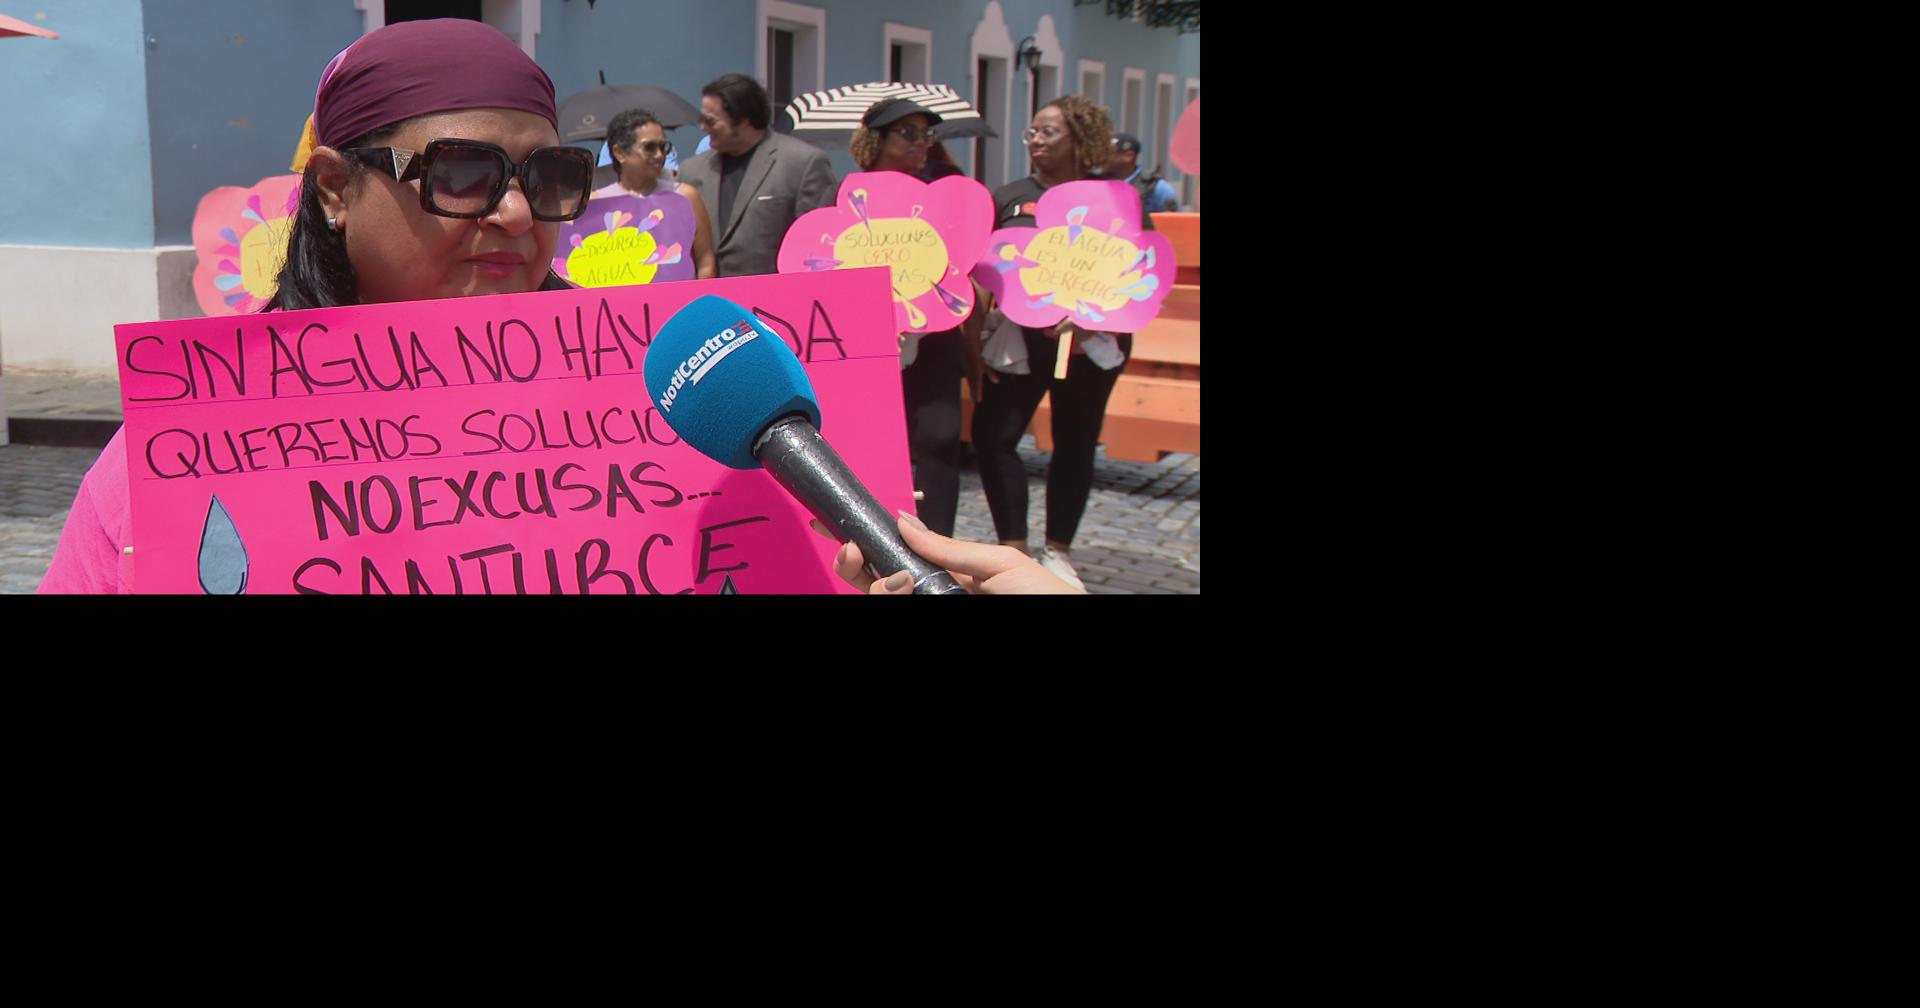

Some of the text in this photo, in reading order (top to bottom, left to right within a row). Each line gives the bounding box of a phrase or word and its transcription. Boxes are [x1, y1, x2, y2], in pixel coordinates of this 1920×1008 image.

[863, 247, 912, 266] CERO
[1035, 250, 1097, 272] ES UN
[1048, 232, 1126, 261] EL AGUA
[585, 262, 637, 288] AGUA
[1036, 266, 1119, 302] DERECHO
[126, 328, 246, 401] SIN
[266, 322, 448, 398] AGUA
[454, 319, 542, 384] NO
[659, 327, 737, 414] NotiCentro
[145, 405, 681, 479] QUEREMOS SOLUCIO
[308, 474, 402, 541] NO
